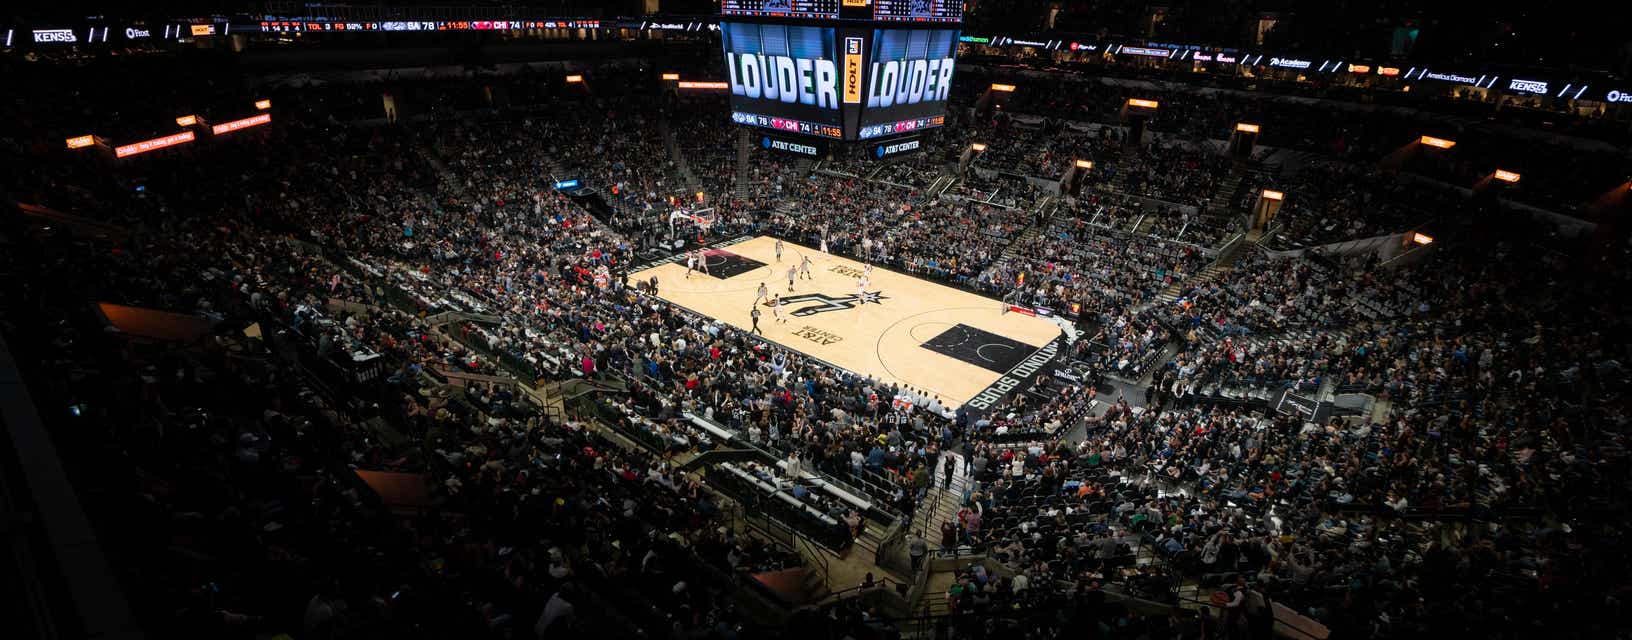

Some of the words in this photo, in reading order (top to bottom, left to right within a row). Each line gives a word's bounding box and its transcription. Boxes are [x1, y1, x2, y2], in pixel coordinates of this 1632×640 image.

[407, 22, 420, 30] SA
[422, 22, 435, 30] 78
[493, 21, 507, 29] CHI
[509, 21, 521, 29] 74
[849, 39, 859, 53] CAT
[728, 52, 839, 109] LOUDER
[848, 59, 857, 95] HOLT
[867, 58, 954, 108] LOUDER
[785, 121, 798, 130] CHI
[800, 123, 809, 132] 74
[822, 126, 842, 138] 11:55
[772, 140, 788, 150] AT&T
[789, 142, 817, 155] CENTER
[885, 144, 898, 154] AT&T
[898, 141, 920, 152] CENTER
[792, 330, 836, 345] AT&T
[968, 376, 1020, 410] SPURS
